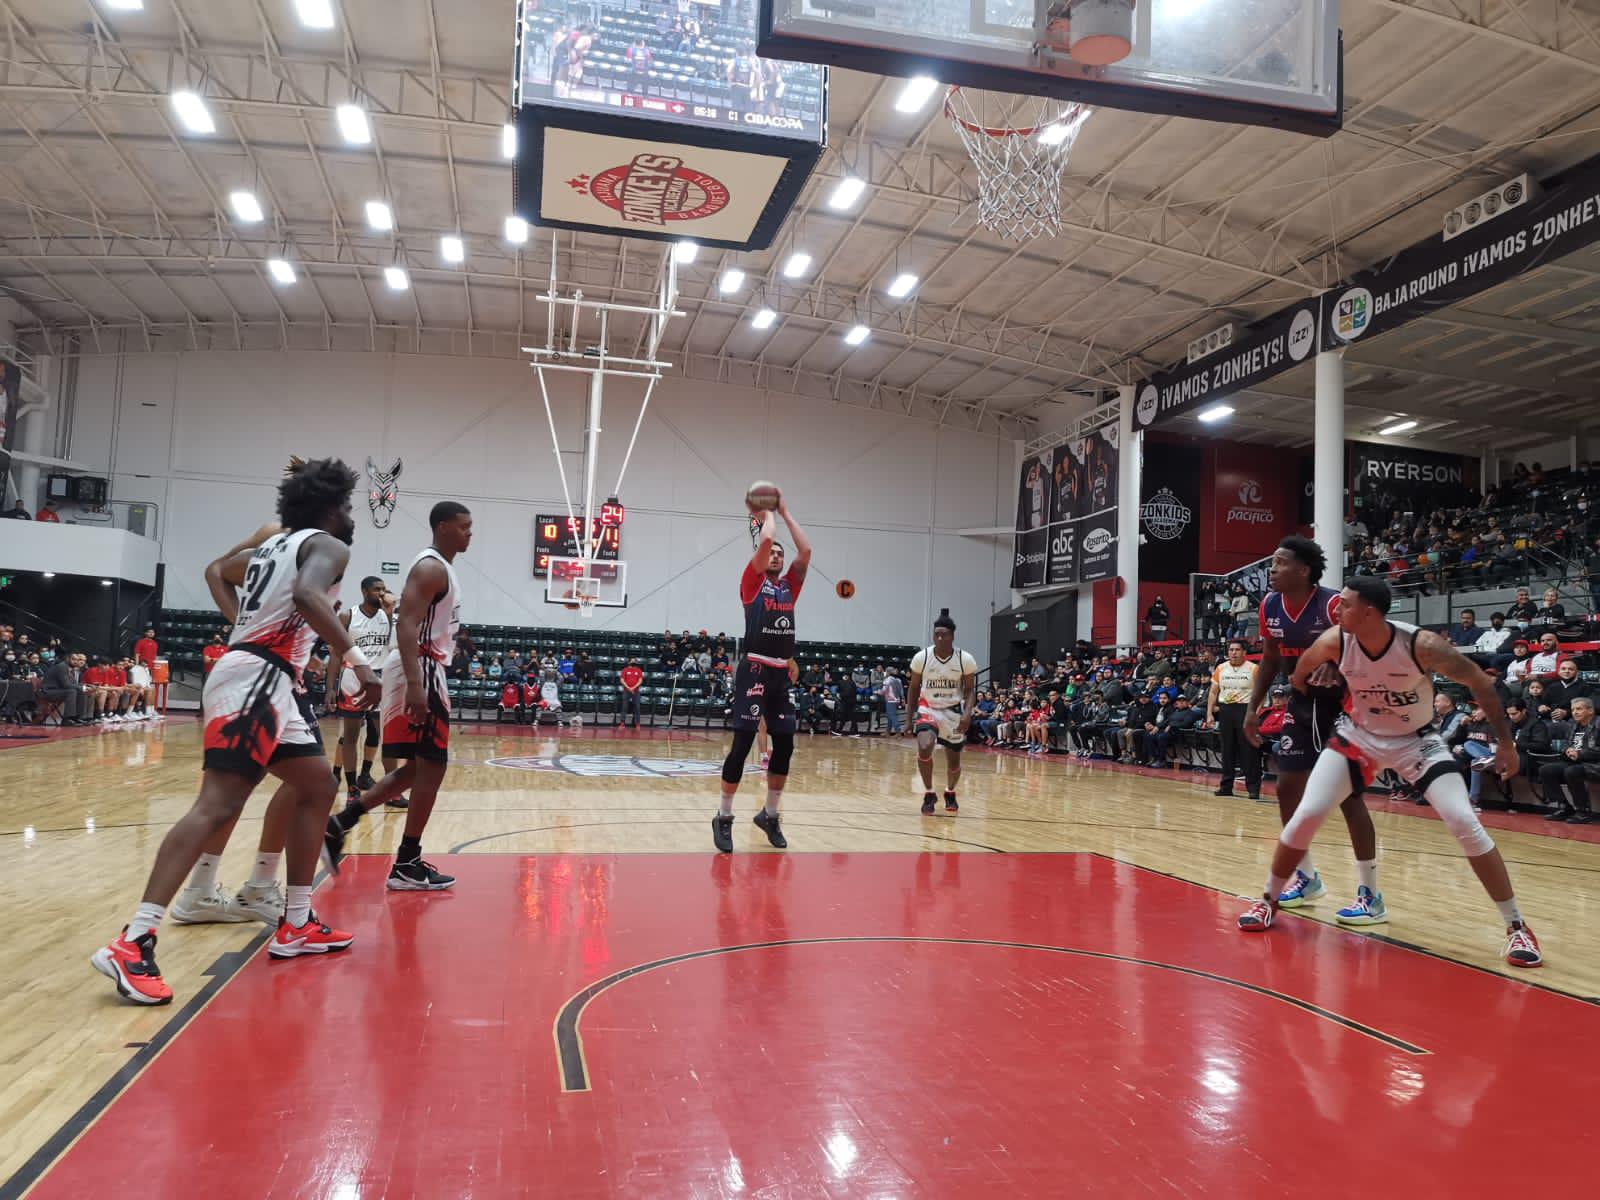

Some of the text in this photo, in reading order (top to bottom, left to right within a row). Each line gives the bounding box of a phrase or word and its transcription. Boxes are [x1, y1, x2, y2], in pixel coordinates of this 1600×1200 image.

[744, 112, 804, 130] CIBACOPA
[594, 173, 622, 203] TIJUANA
[621, 154, 684, 225] ZONKEYS
[1374, 262, 1458, 315] BAJAROUND
[1367, 460, 1463, 483] RYERSON
[602, 505, 623, 522] 24
[1141, 504, 1190, 523] ZONKIDS
[544, 524, 557, 539] 10
[606, 528, 618, 541] 11
[841, 582, 851, 596] C
